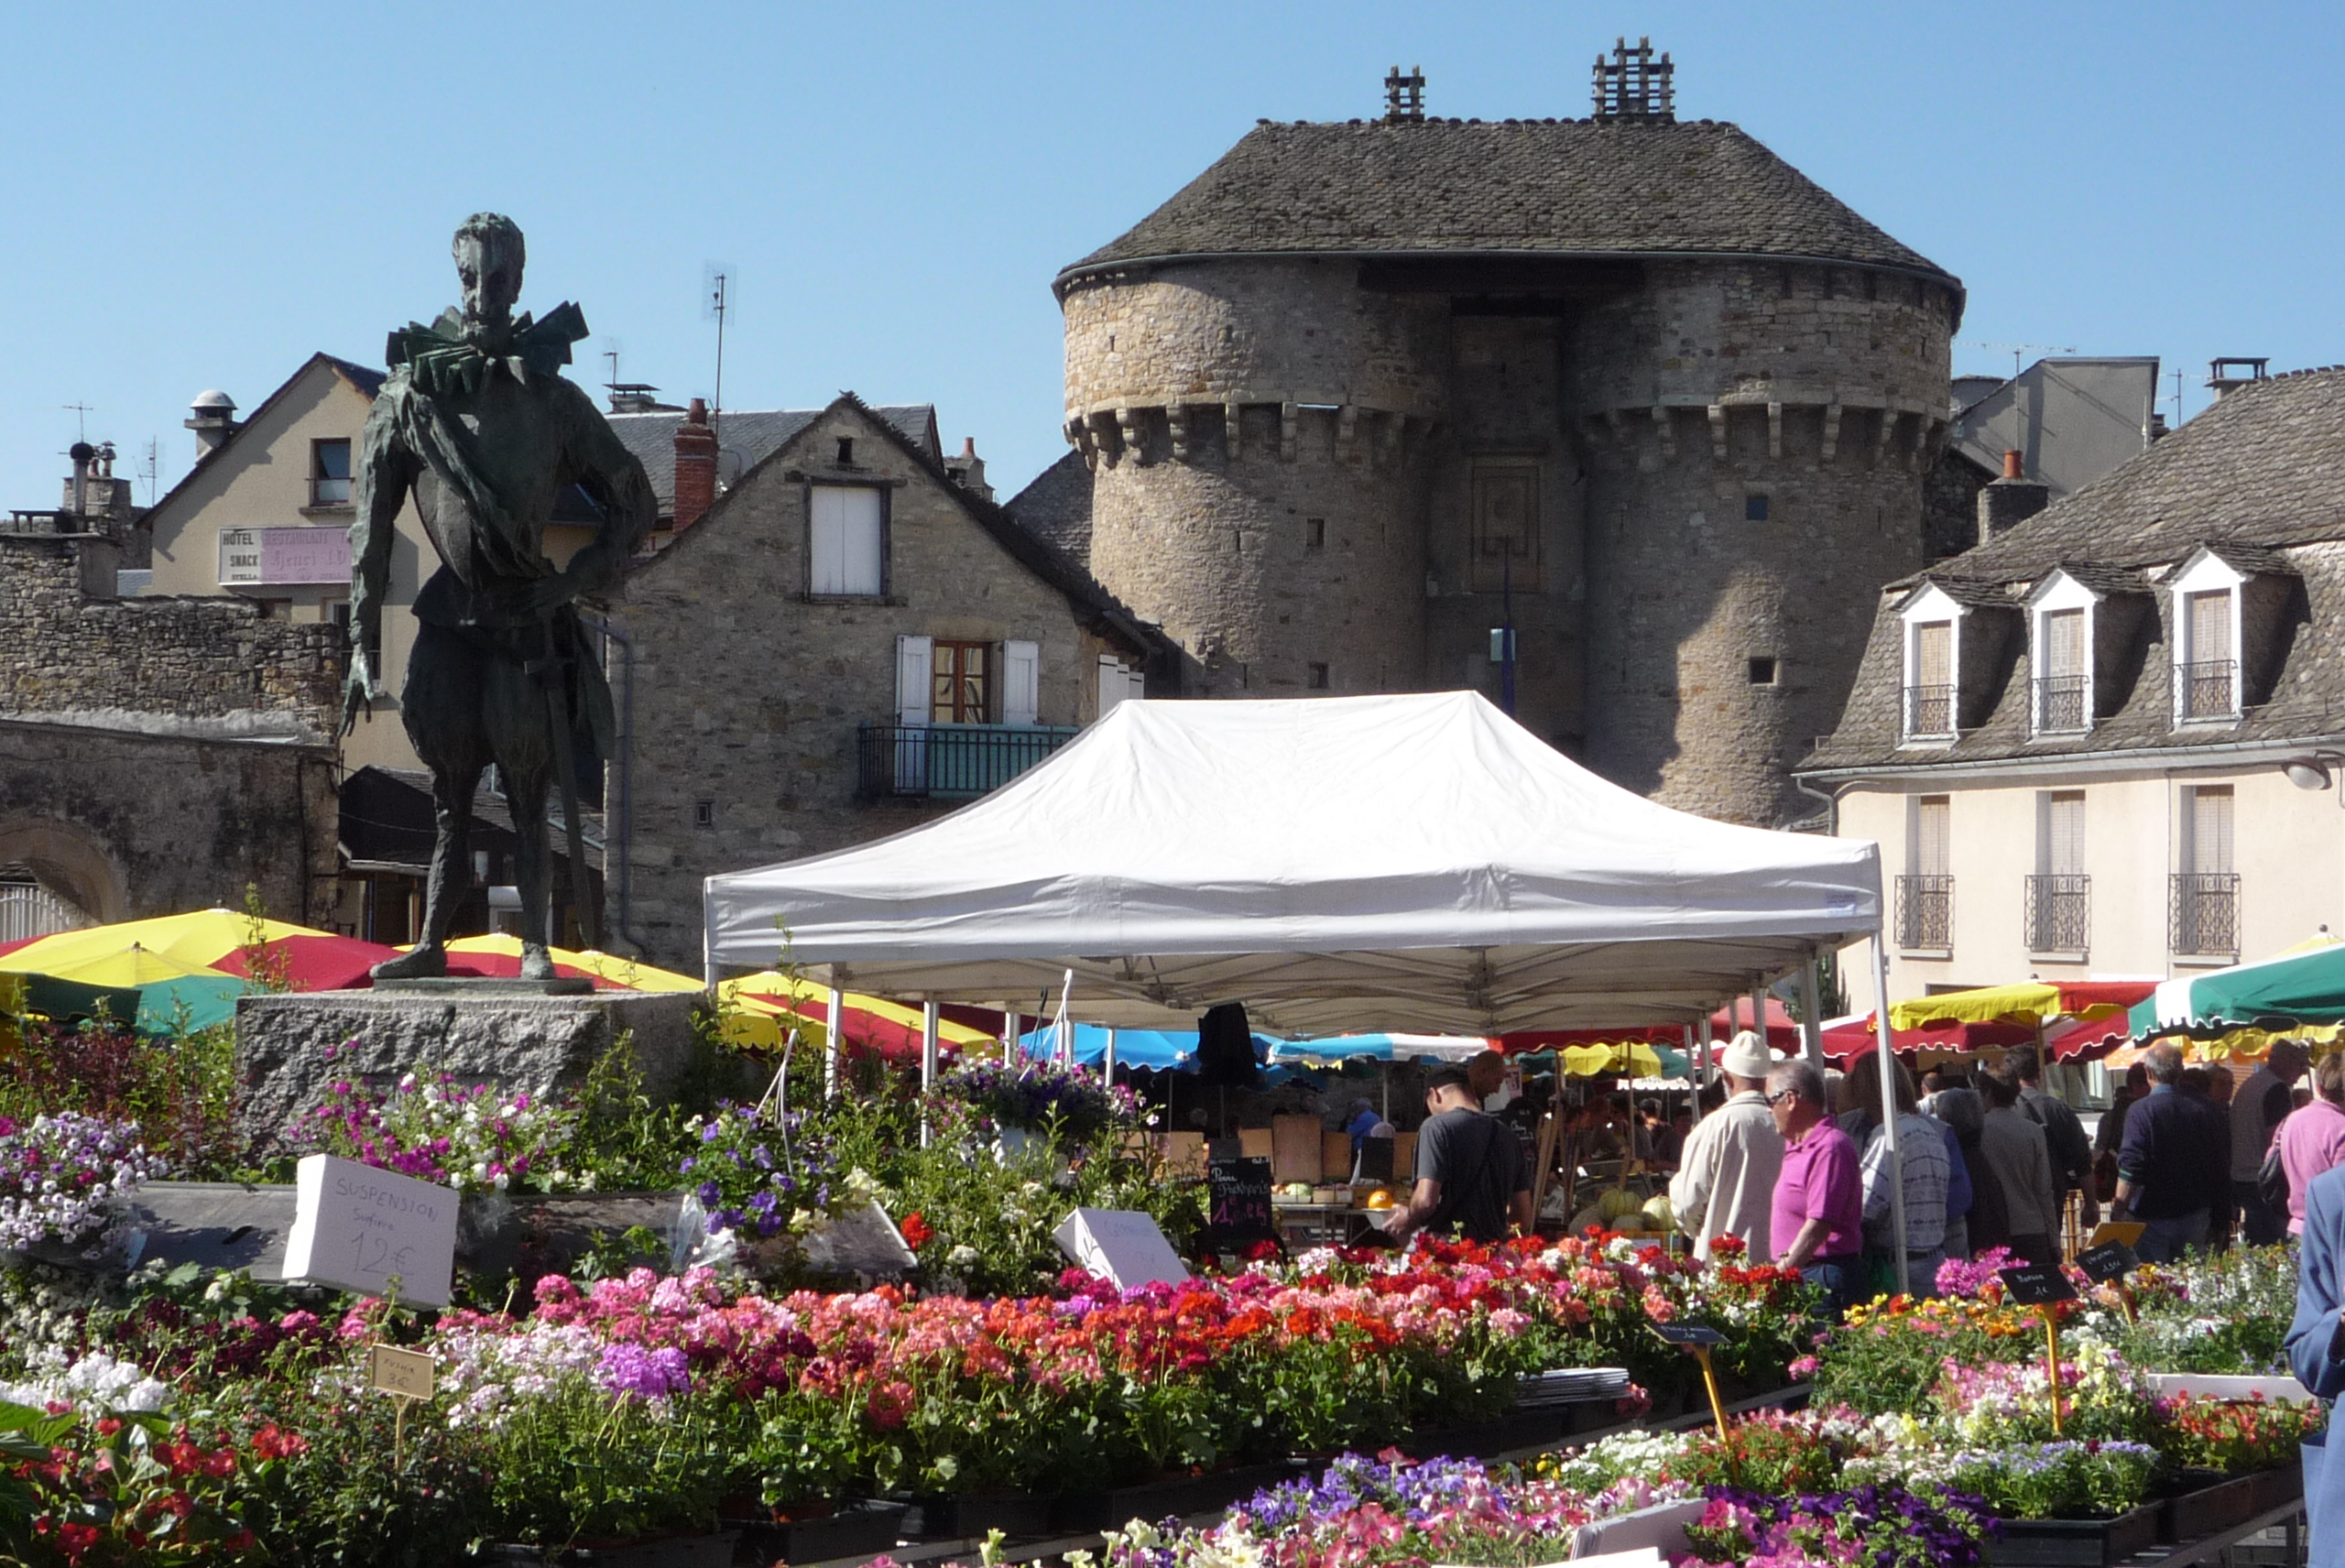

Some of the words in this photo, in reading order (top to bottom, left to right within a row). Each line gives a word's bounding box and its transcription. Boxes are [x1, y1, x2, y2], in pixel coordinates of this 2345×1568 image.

[223, 532, 255, 545] HOTEL
[264, 531, 329, 545] RESTAURANT
[230, 554, 258, 567] SNACK
[335, 1178, 439, 1222] SUSPENSION
[351, 1231, 416, 1276] 12€
